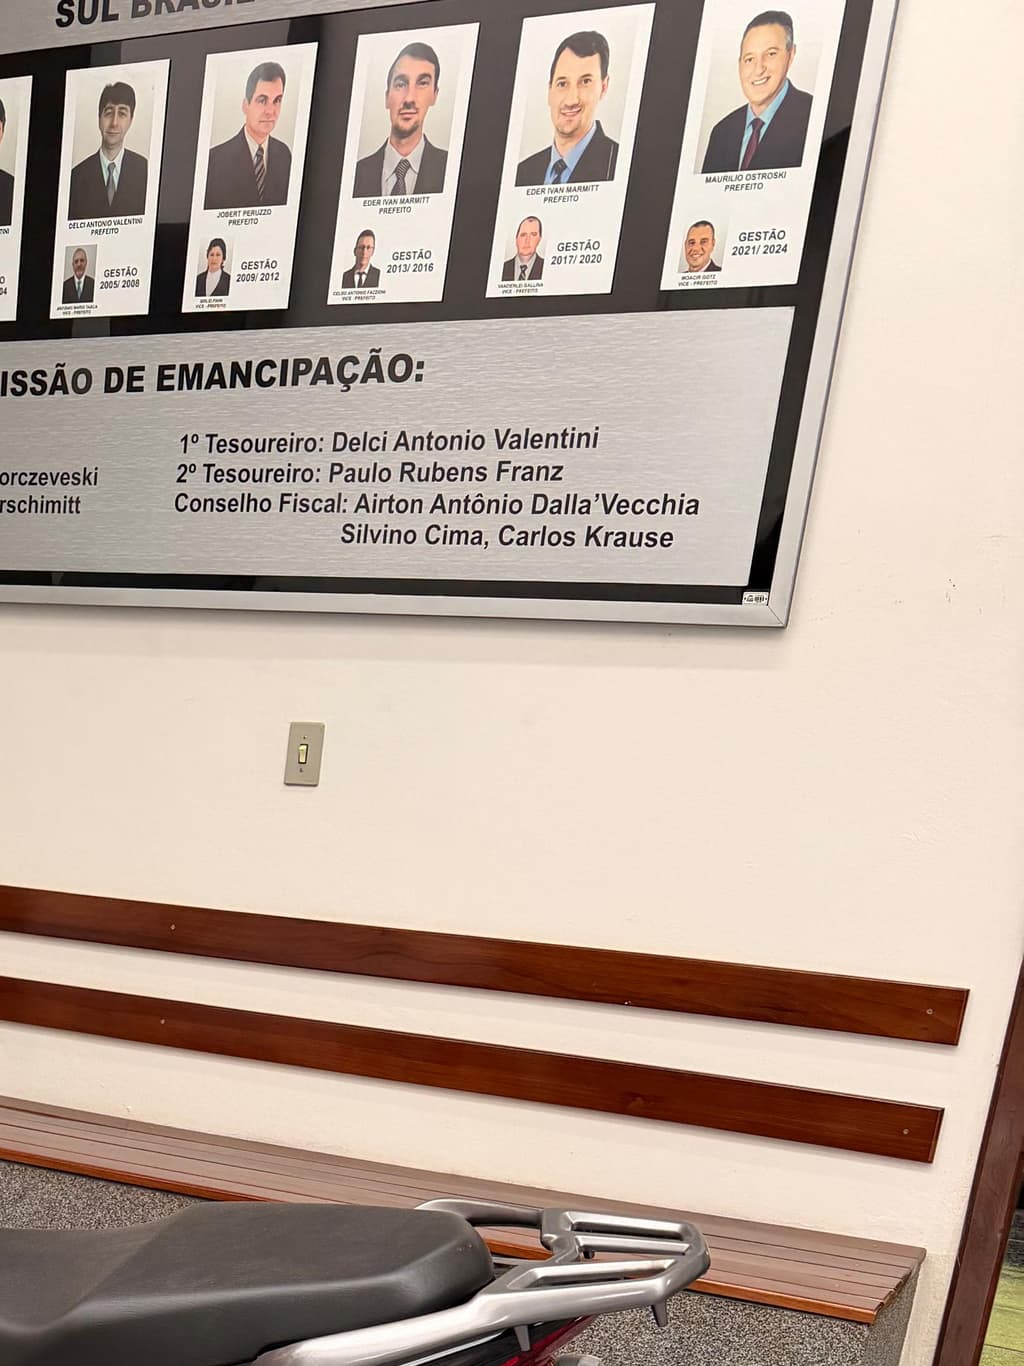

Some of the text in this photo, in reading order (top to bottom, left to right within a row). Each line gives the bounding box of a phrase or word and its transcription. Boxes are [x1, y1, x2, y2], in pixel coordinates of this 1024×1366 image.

[55, 0, 119, 27] SUL
[705, 170, 787, 184] MAURILIO OSTROSKI
[526, 184, 600, 196] EDER IVAN MARMITT
[724, 182, 764, 192] PREFEITO
[382, 198, 398, 206] IVAN
[399, 196, 430, 204] MARMITT
[543, 195, 579, 204] PREFEITO
[378, 206, 412, 215] PREFEITO
[68, 217, 143, 230] DELCI ANTONIO VALENTINI
[228, 218, 258, 226] PREFEITO
[90, 228, 119, 236] PREFEITO
[738, 228, 786, 242] GESTÃO
[557, 239, 601, 252] GESTÃO
[731, 243, 788, 256] 2021/ 2024
[392, 248, 432, 261] GESTÃO
[550, 254, 602, 266] 2017/ 2020
[240, 258, 277, 271] GESTÃO
[386, 262, 434, 274] 2013/ 2016
[103, 266, 138, 278] GESTÃO
[259, 272, 280, 281] 2012
[104, 366, 146, 394] DE
[156, 348, 425, 392] EMANCIPAÇÃO:
[179, 426, 600, 454] 1º Tesoureiro: Delci Antonio Valentini
[176, 460, 564, 483] 2º Tesoureiro: Paulo Rubens Franz
[174, 492, 272, 513] Conselho
[279, 492, 347, 513] Fiscal:
[353, 493, 423, 514] Airton
[429, 492, 524, 515] Antônio
[341, 523, 674, 549] Silvino Cima, Carlos Krause
